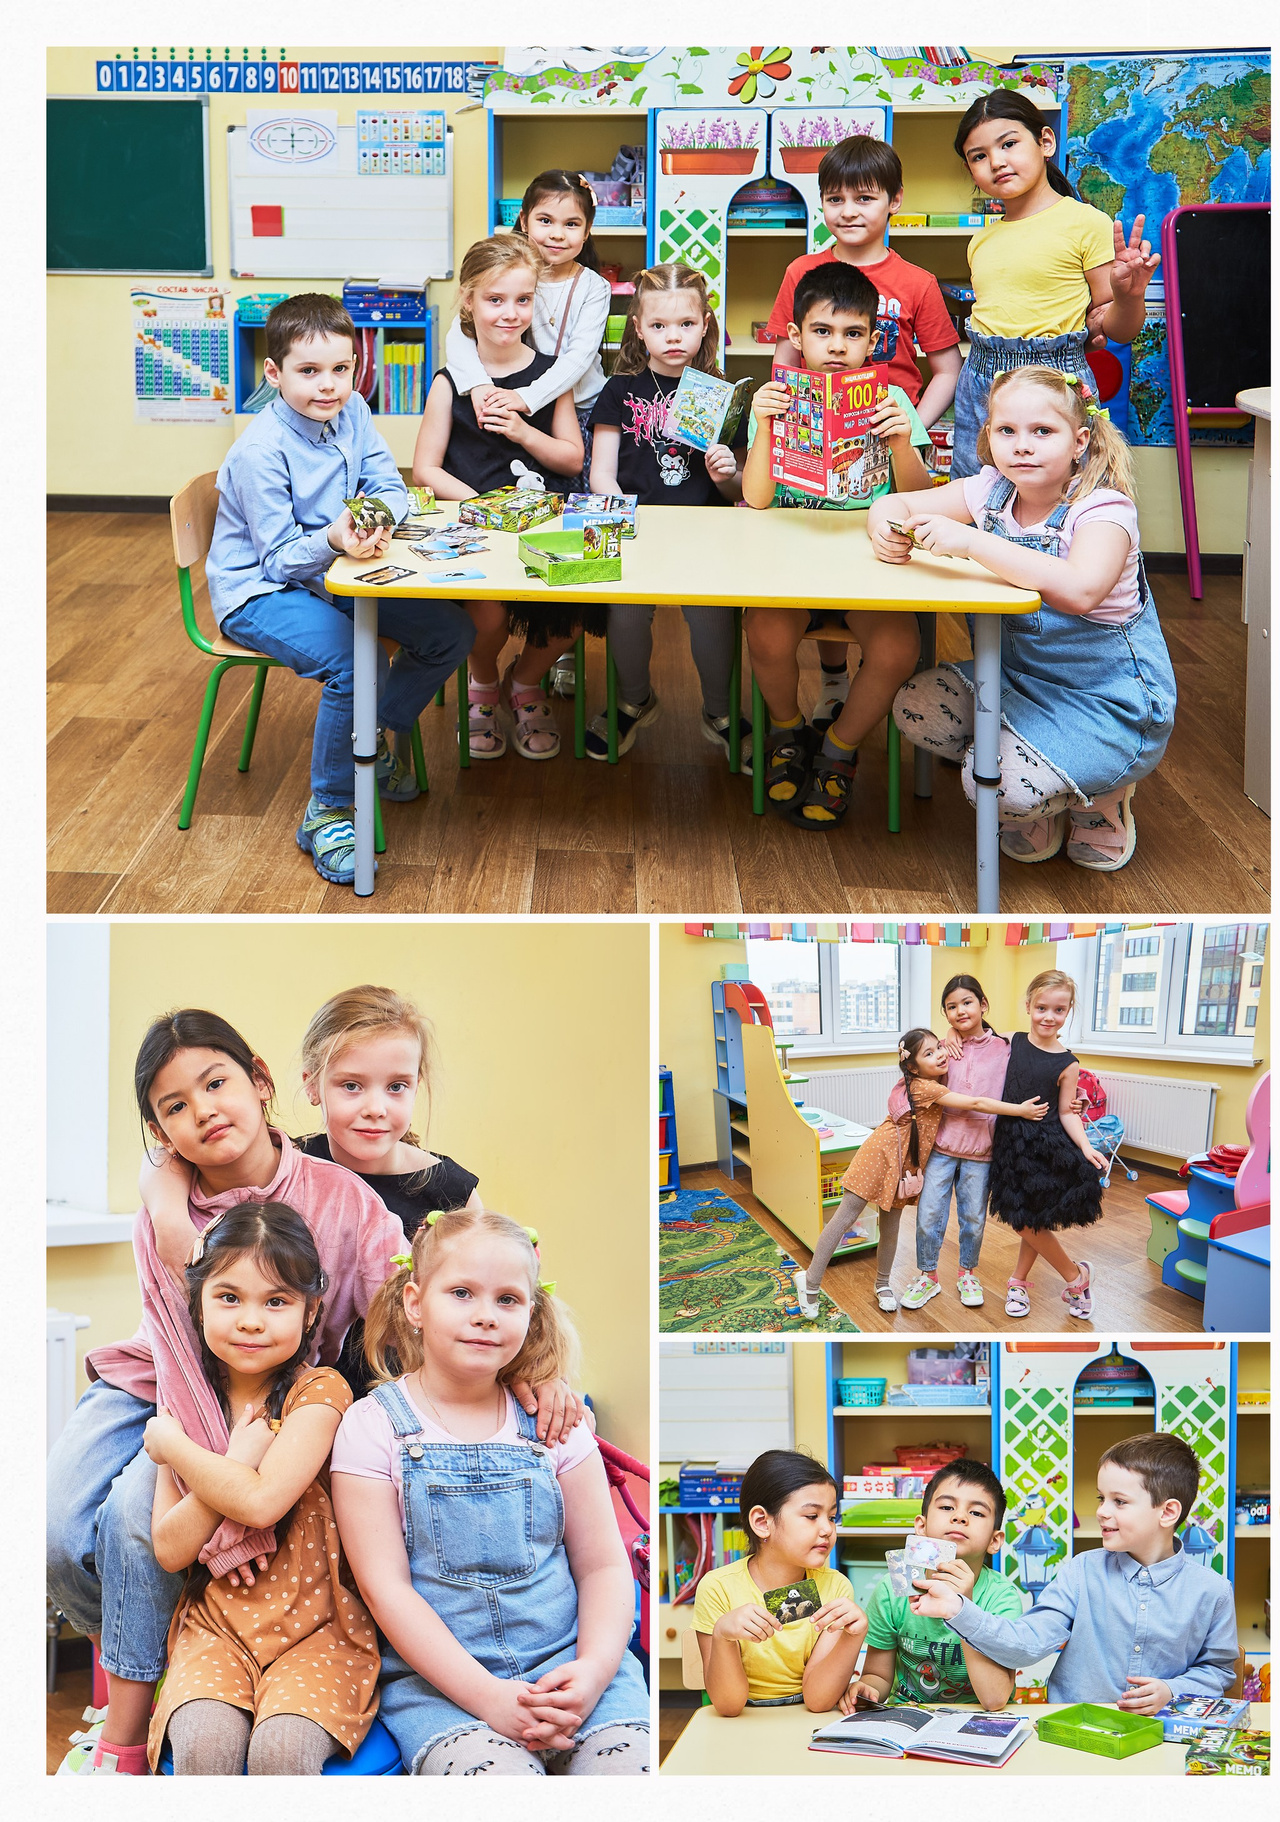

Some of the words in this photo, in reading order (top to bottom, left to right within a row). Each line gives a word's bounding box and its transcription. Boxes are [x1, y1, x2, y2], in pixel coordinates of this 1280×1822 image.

[100, 65, 112, 88] 0
[118, 65, 128, 88] 1
[136, 65, 148, 88] 2
[154, 65, 166, 88] 3
[172, 66, 185, 89] 4
[191, 66, 202, 89] 5
[209, 66, 221, 89] 6
[227, 66, 239, 89] 7
[245, 66, 257, 89] 8
[264, 66, 276, 89] 9
[280, 66, 298, 89] 10
[301, 66, 317, 89] 11
[321, 66, 339, 89] 12
[342, 66, 359, 89] 13
[362, 66, 381, 89] 14
[383, 66, 400, 89] 15
[403, 66, 422, 89] 16
[424, 66, 442, 89] 17
[444, 66, 463, 89] 18
[846, 383, 874, 410] 100
[1225, 1763, 1262, 1776] MEMO
